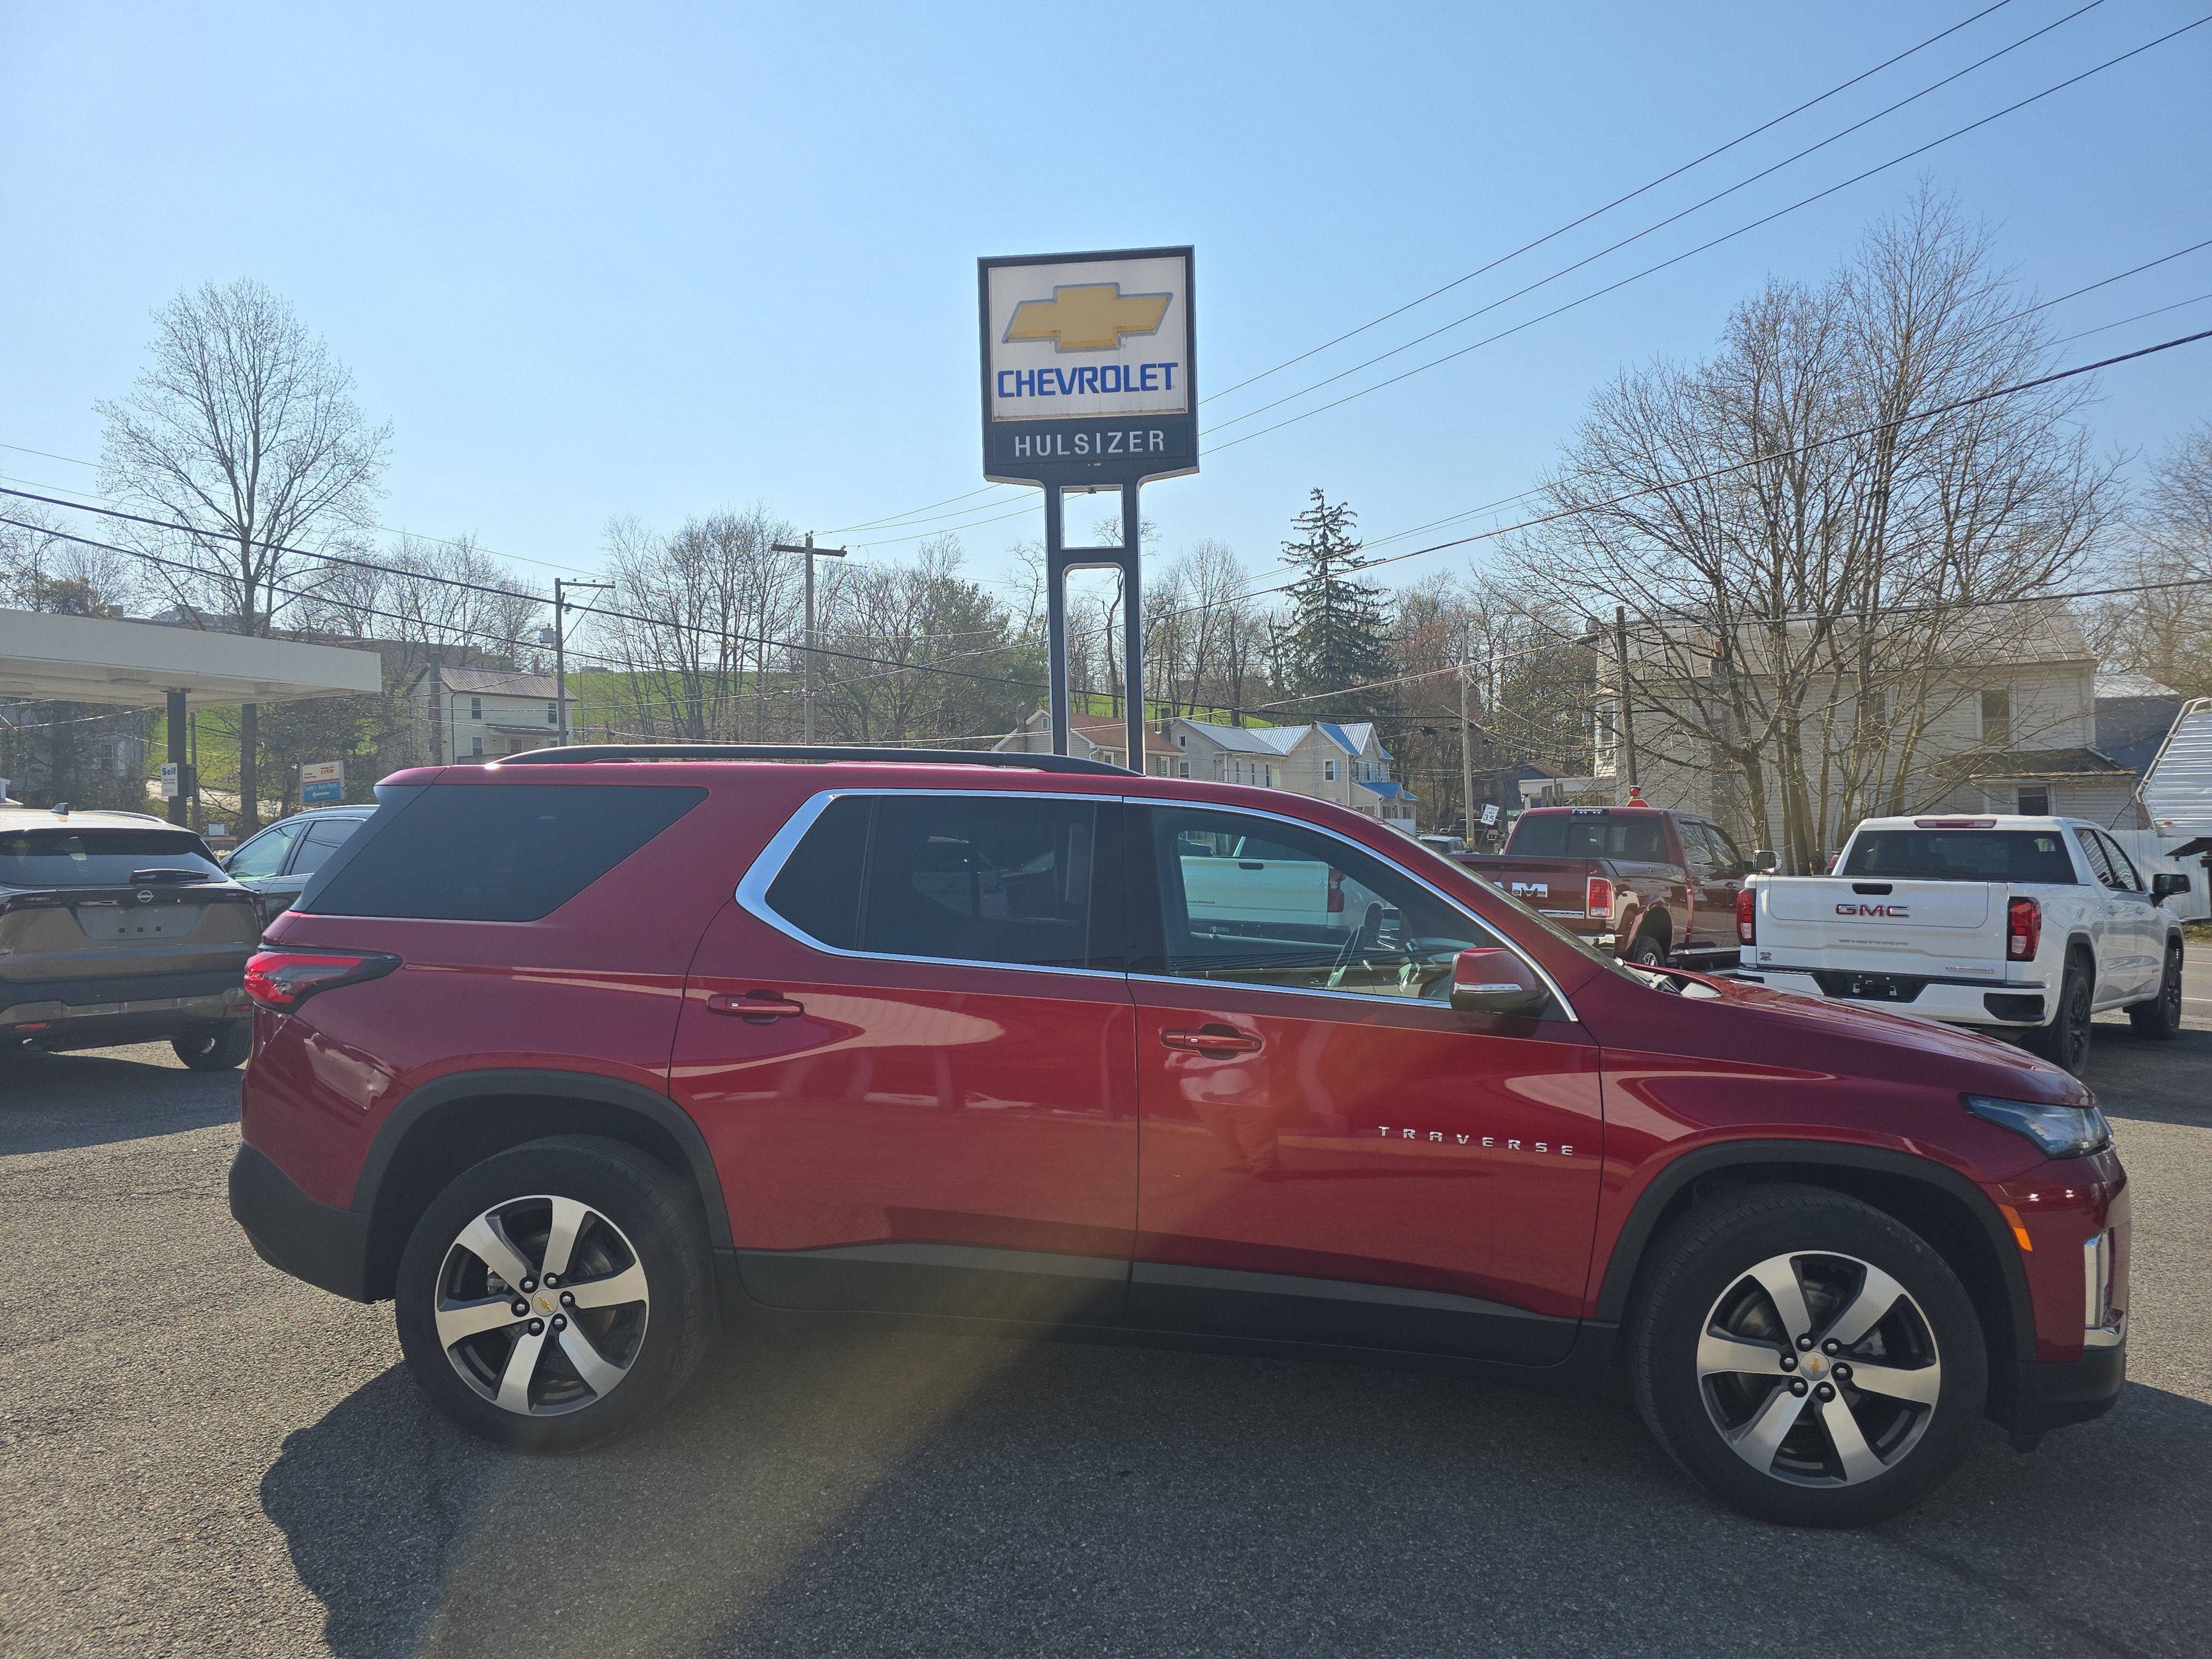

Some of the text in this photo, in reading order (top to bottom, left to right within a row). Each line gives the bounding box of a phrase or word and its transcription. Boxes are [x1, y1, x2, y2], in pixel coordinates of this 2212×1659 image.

[998, 362, 1179, 398] CHEVROLET
[1015, 430, 1165, 457] HULSIZER
[162, 767, 176, 775] Self
[1483, 814, 1495, 822] 35
[1835, 903, 1910, 918] GMC
[1378, 1126, 1573, 1156] TRAVERSE
